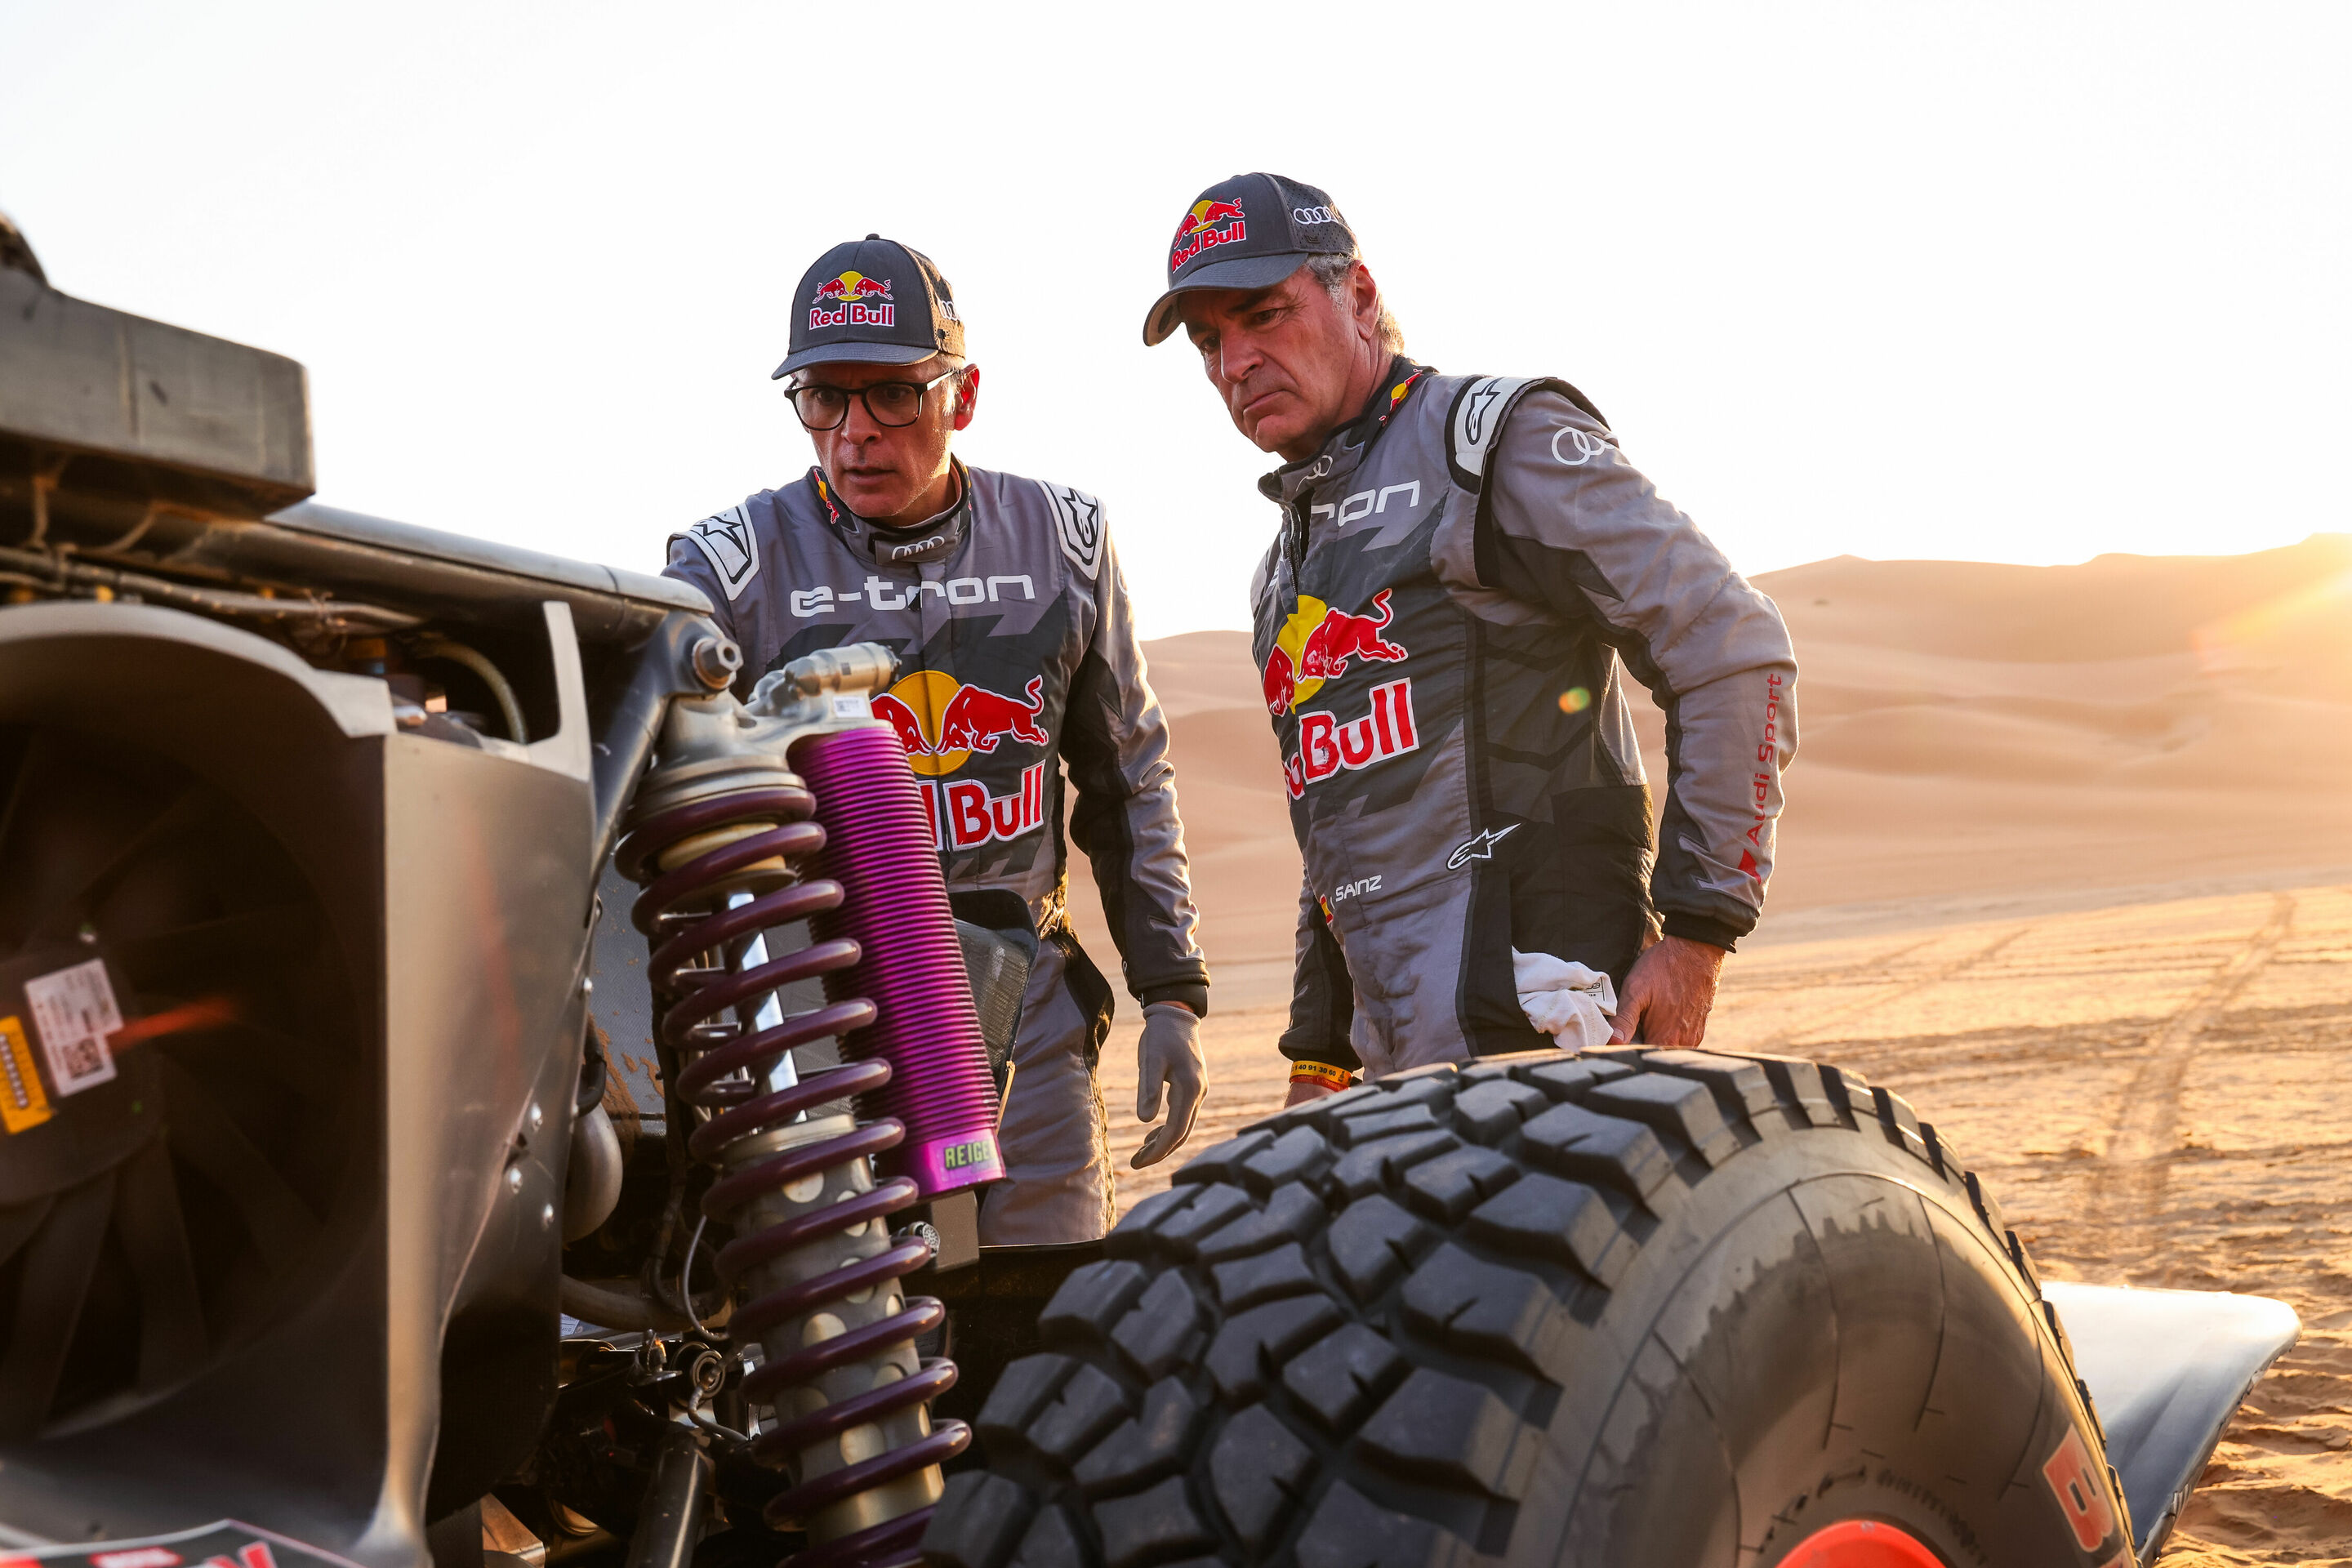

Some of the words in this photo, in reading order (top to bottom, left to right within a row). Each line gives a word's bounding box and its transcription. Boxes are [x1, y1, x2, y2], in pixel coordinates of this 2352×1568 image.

[1171, 234, 1201, 274] Red
[1202, 220, 1246, 250] Bull
[809, 303, 847, 330] Red
[850, 303, 894, 327] Bull
[790, 574, 1036, 618] e-tron
[1298, 676, 1420, 784] Bull
[1757, 673, 1783, 764] Sport
[942, 759, 1045, 852] Bull
[1746, 773, 1771, 848] Audi
[1335, 875, 1382, 902] SAINZ
[944, 1138, 995, 1169] REIGE
